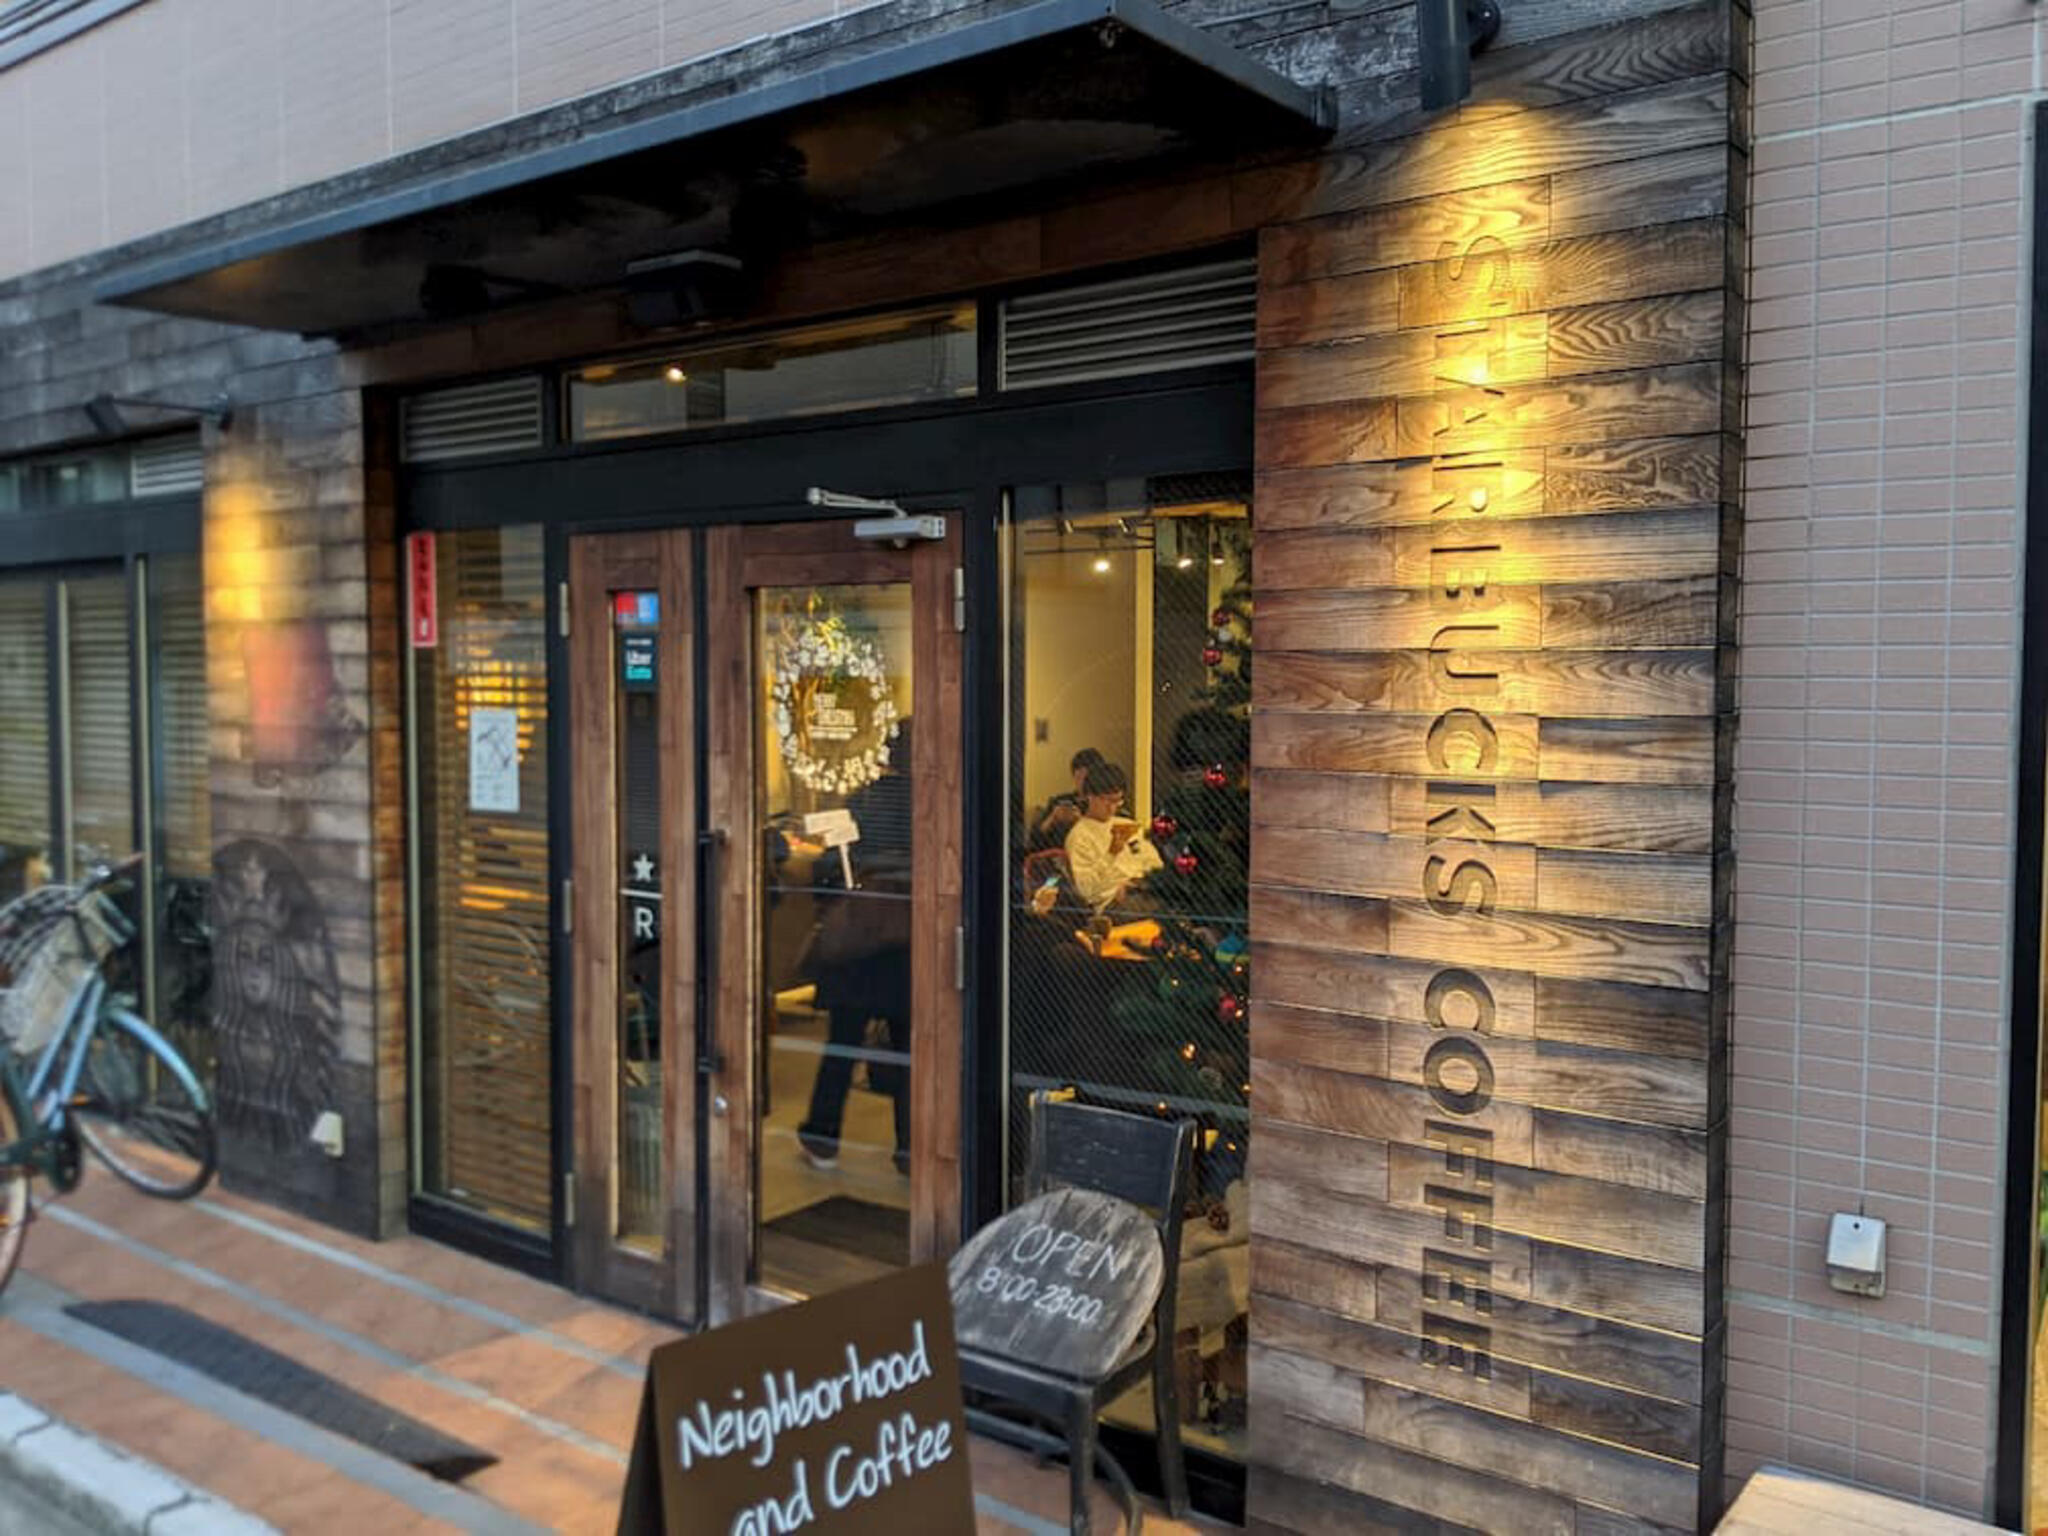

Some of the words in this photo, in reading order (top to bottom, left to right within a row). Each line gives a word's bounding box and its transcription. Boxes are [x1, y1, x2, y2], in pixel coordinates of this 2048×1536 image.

[1424, 234, 1512, 916] STARBUCKS
[634, 906, 655, 940] R
[1421, 967, 1496, 1382] COFFEE
[1012, 1223, 1122, 1281] OPEN
[678, 1319, 932, 1470] Neighborhood
[732, 1458, 815, 1536] and
[826, 1411, 953, 1509] Coffee
